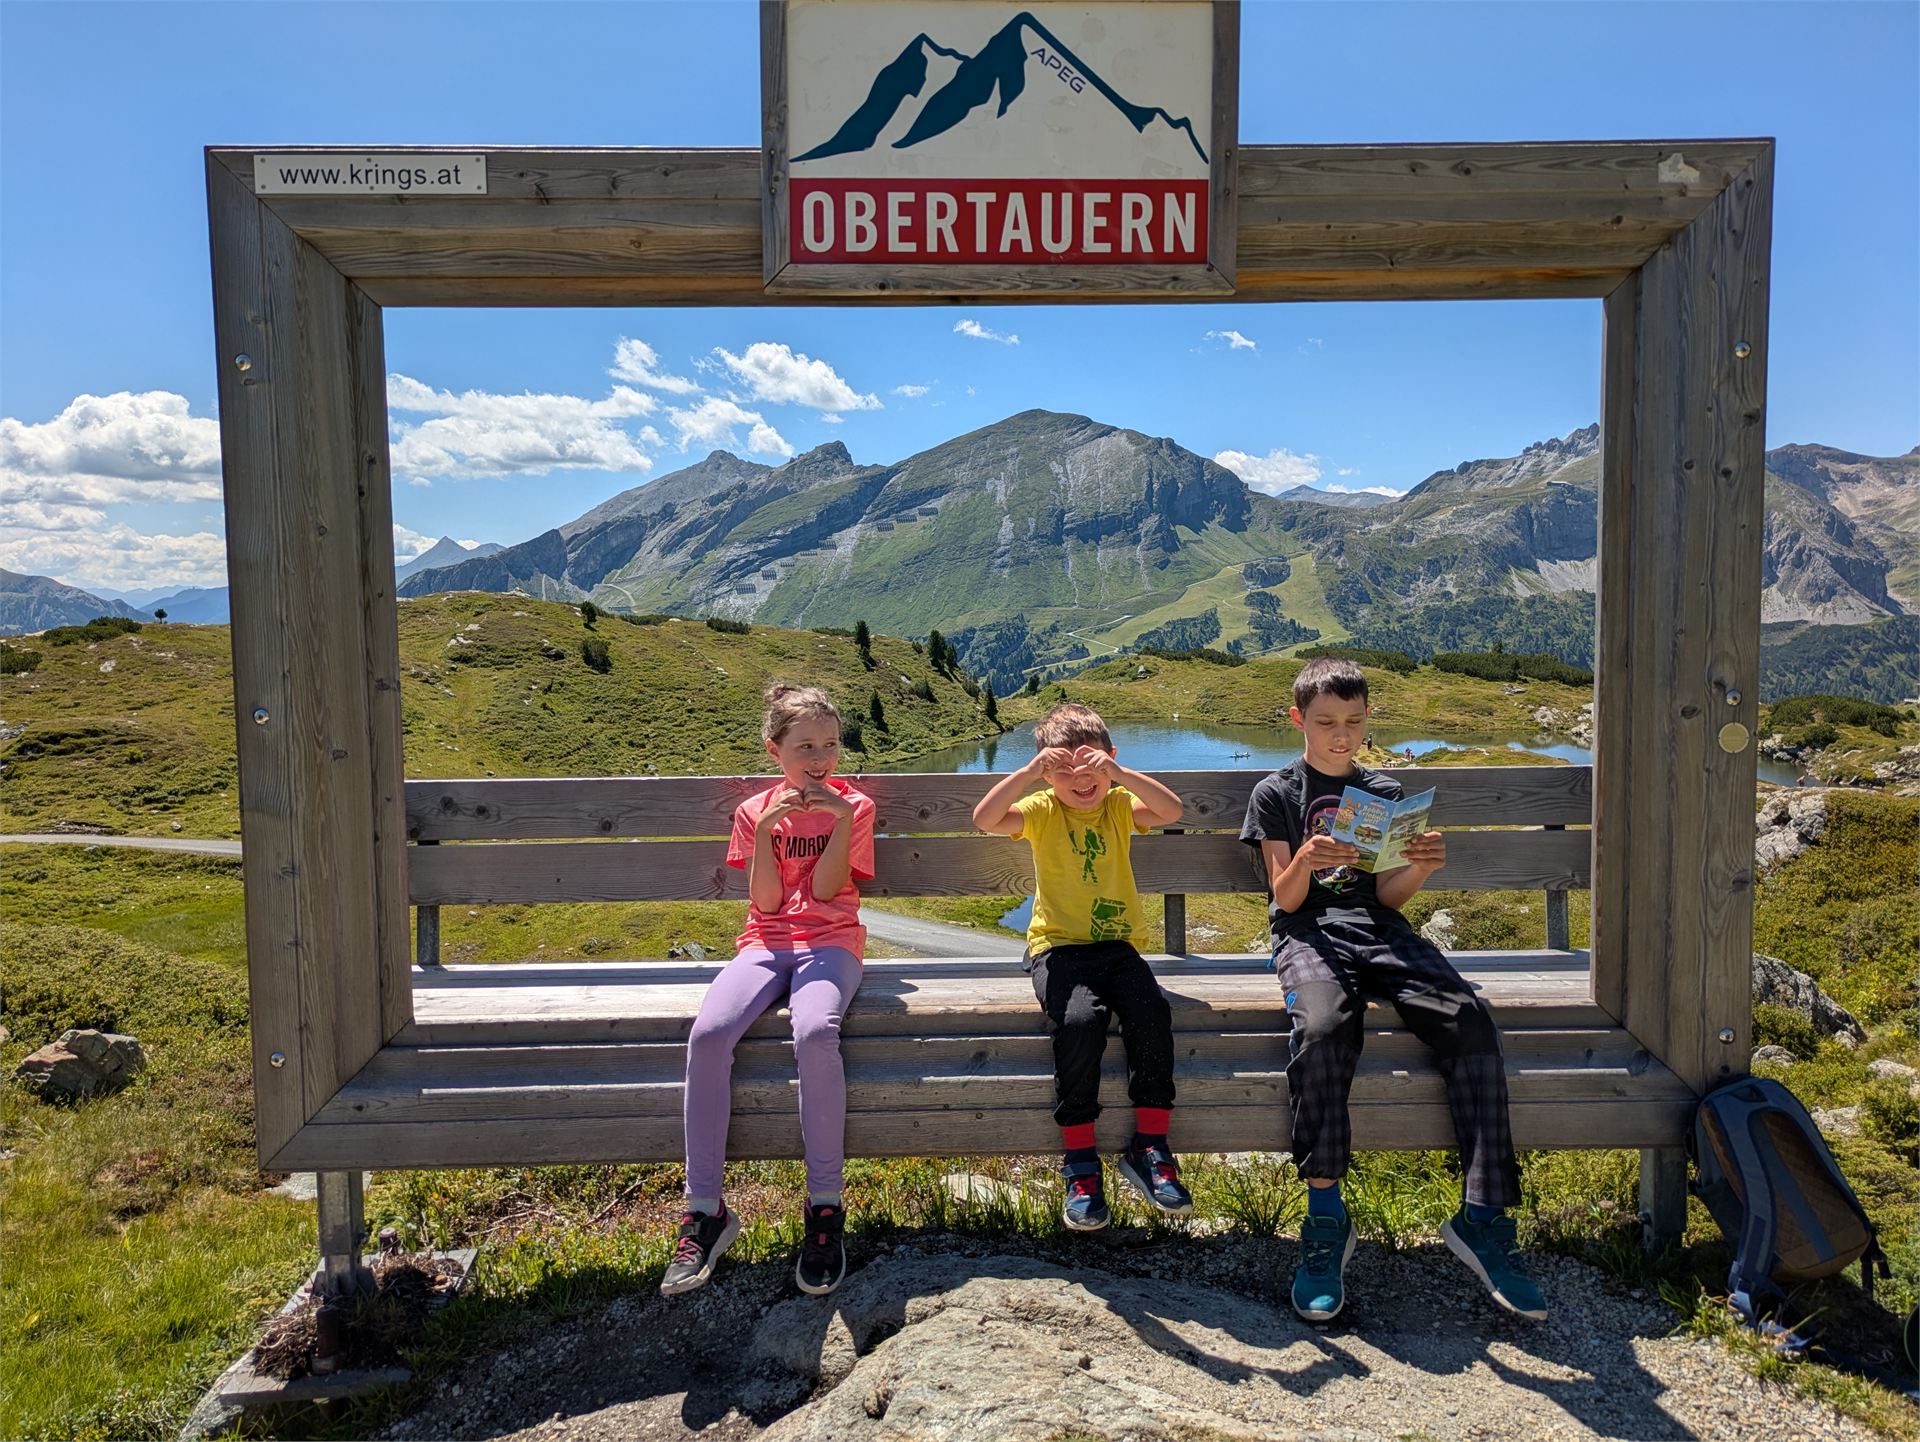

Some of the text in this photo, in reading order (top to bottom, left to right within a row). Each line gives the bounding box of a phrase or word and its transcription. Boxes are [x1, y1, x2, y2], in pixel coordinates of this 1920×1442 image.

[1030, 47, 1086, 94] APEG
[279, 163, 462, 190] www.krings.at
[801, 190, 1197, 254] OBERTAUERN
